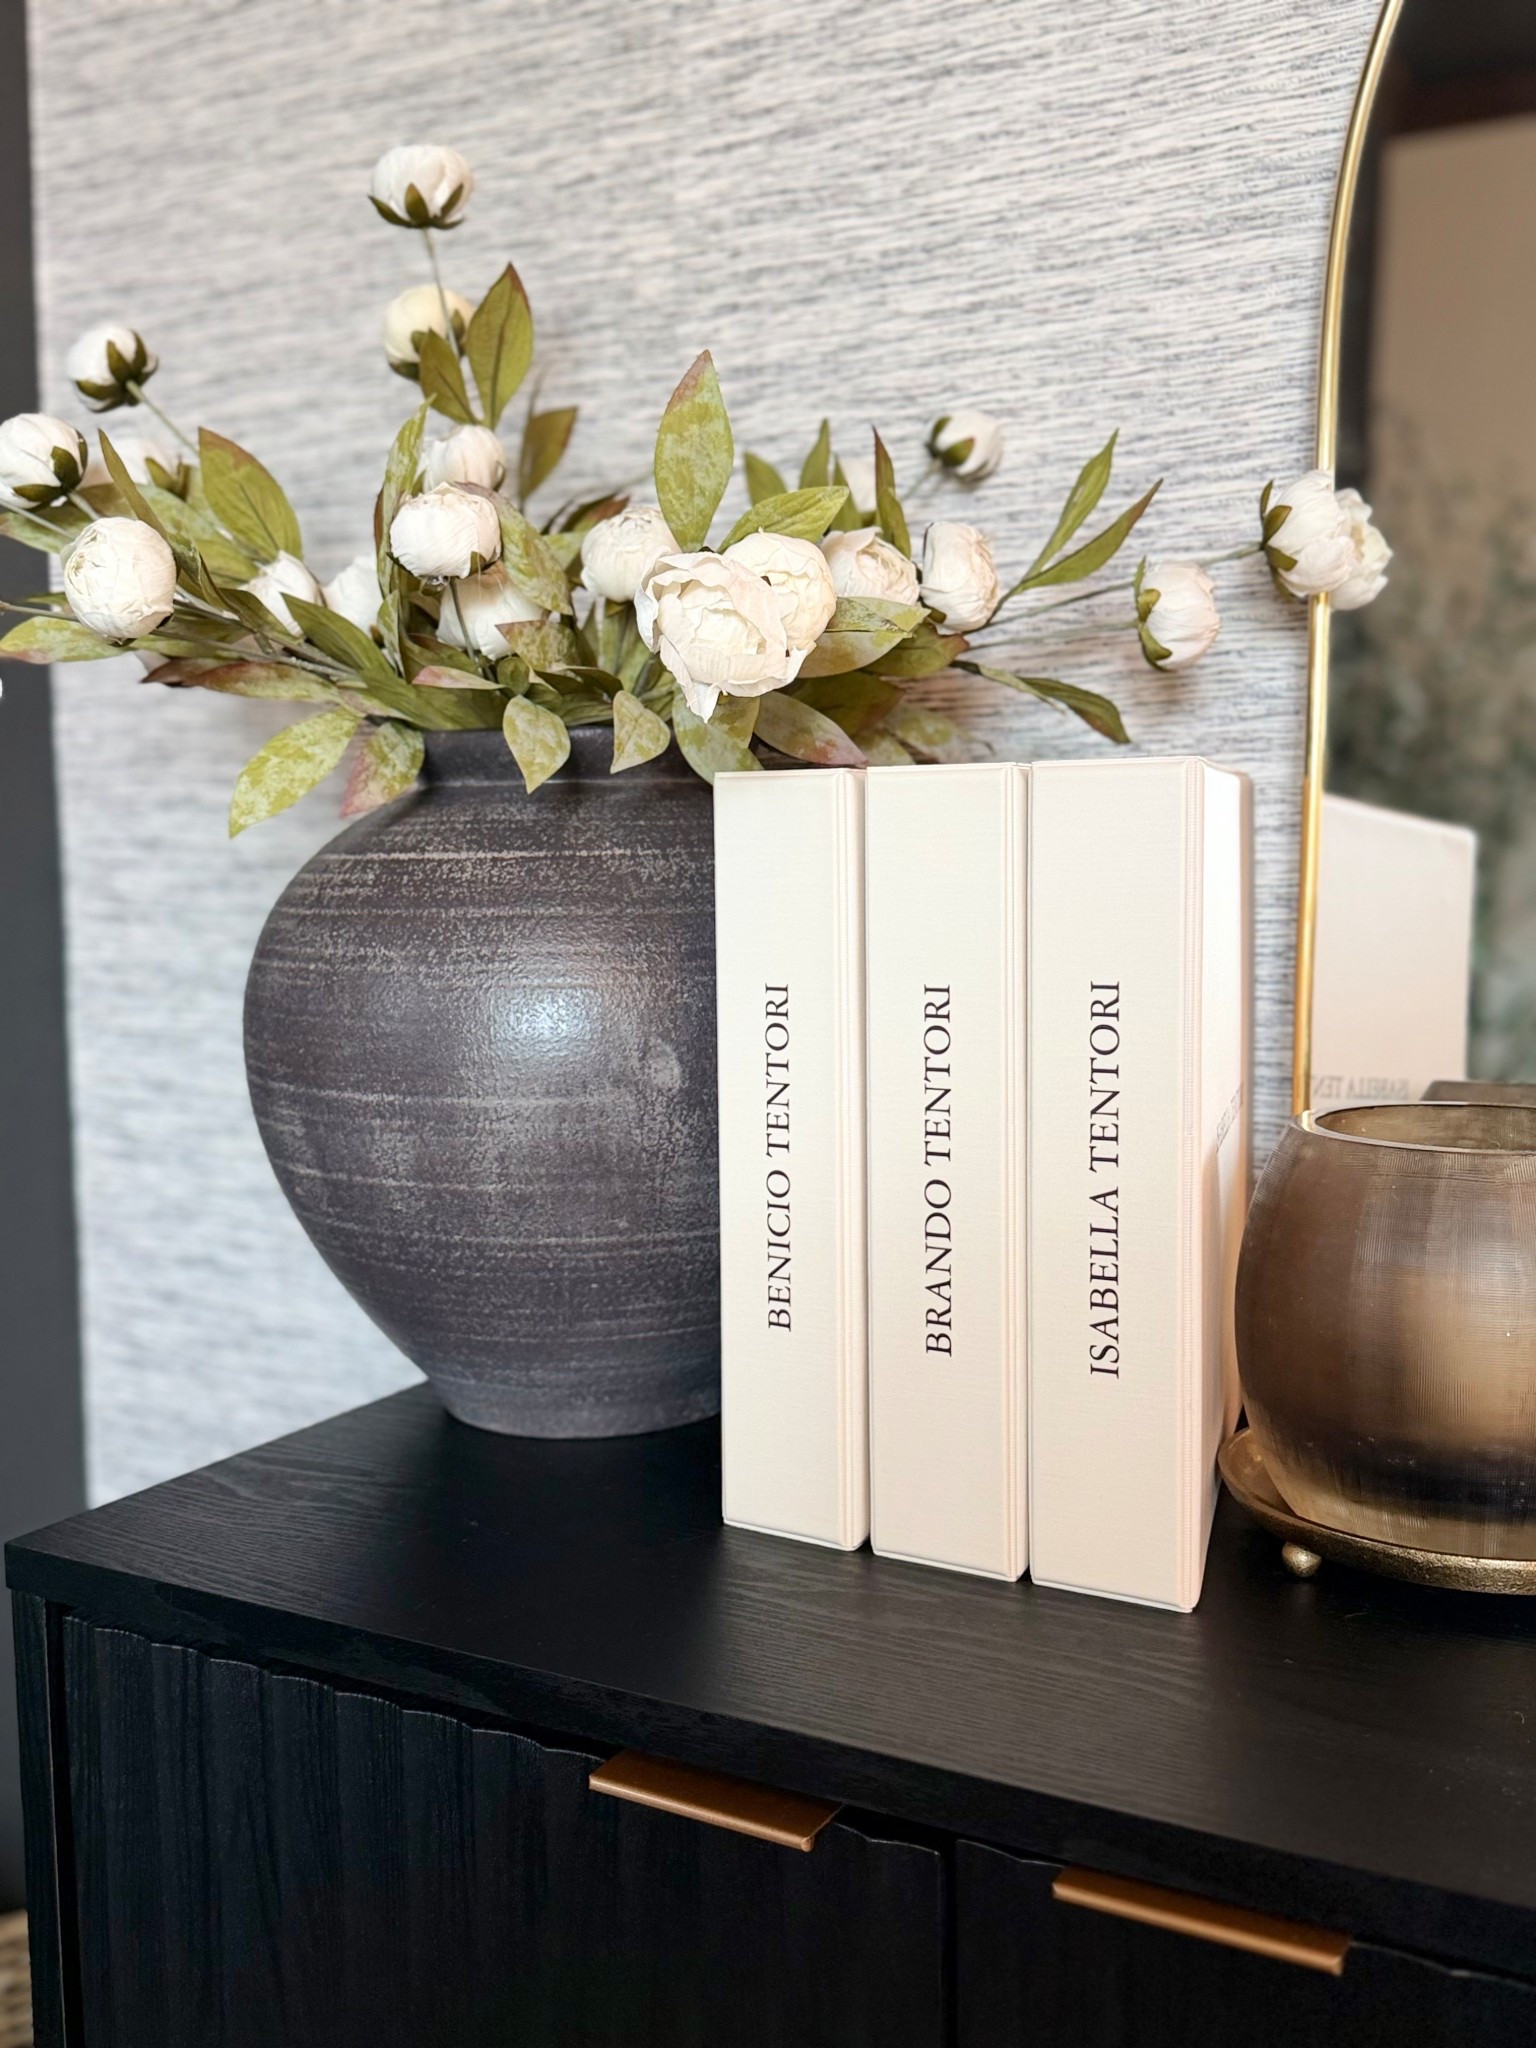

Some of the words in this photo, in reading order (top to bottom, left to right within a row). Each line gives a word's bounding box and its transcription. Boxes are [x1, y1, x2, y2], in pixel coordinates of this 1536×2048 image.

[764, 983, 790, 1158] TENTORI
[923, 983, 952, 1168] TENTORI
[1088, 980, 1121, 1174] TENTORI
[765, 1168, 792, 1333] BENICIO
[924, 1178, 953, 1359] BRANDO
[1088, 1185, 1120, 1380] ISABELLA
